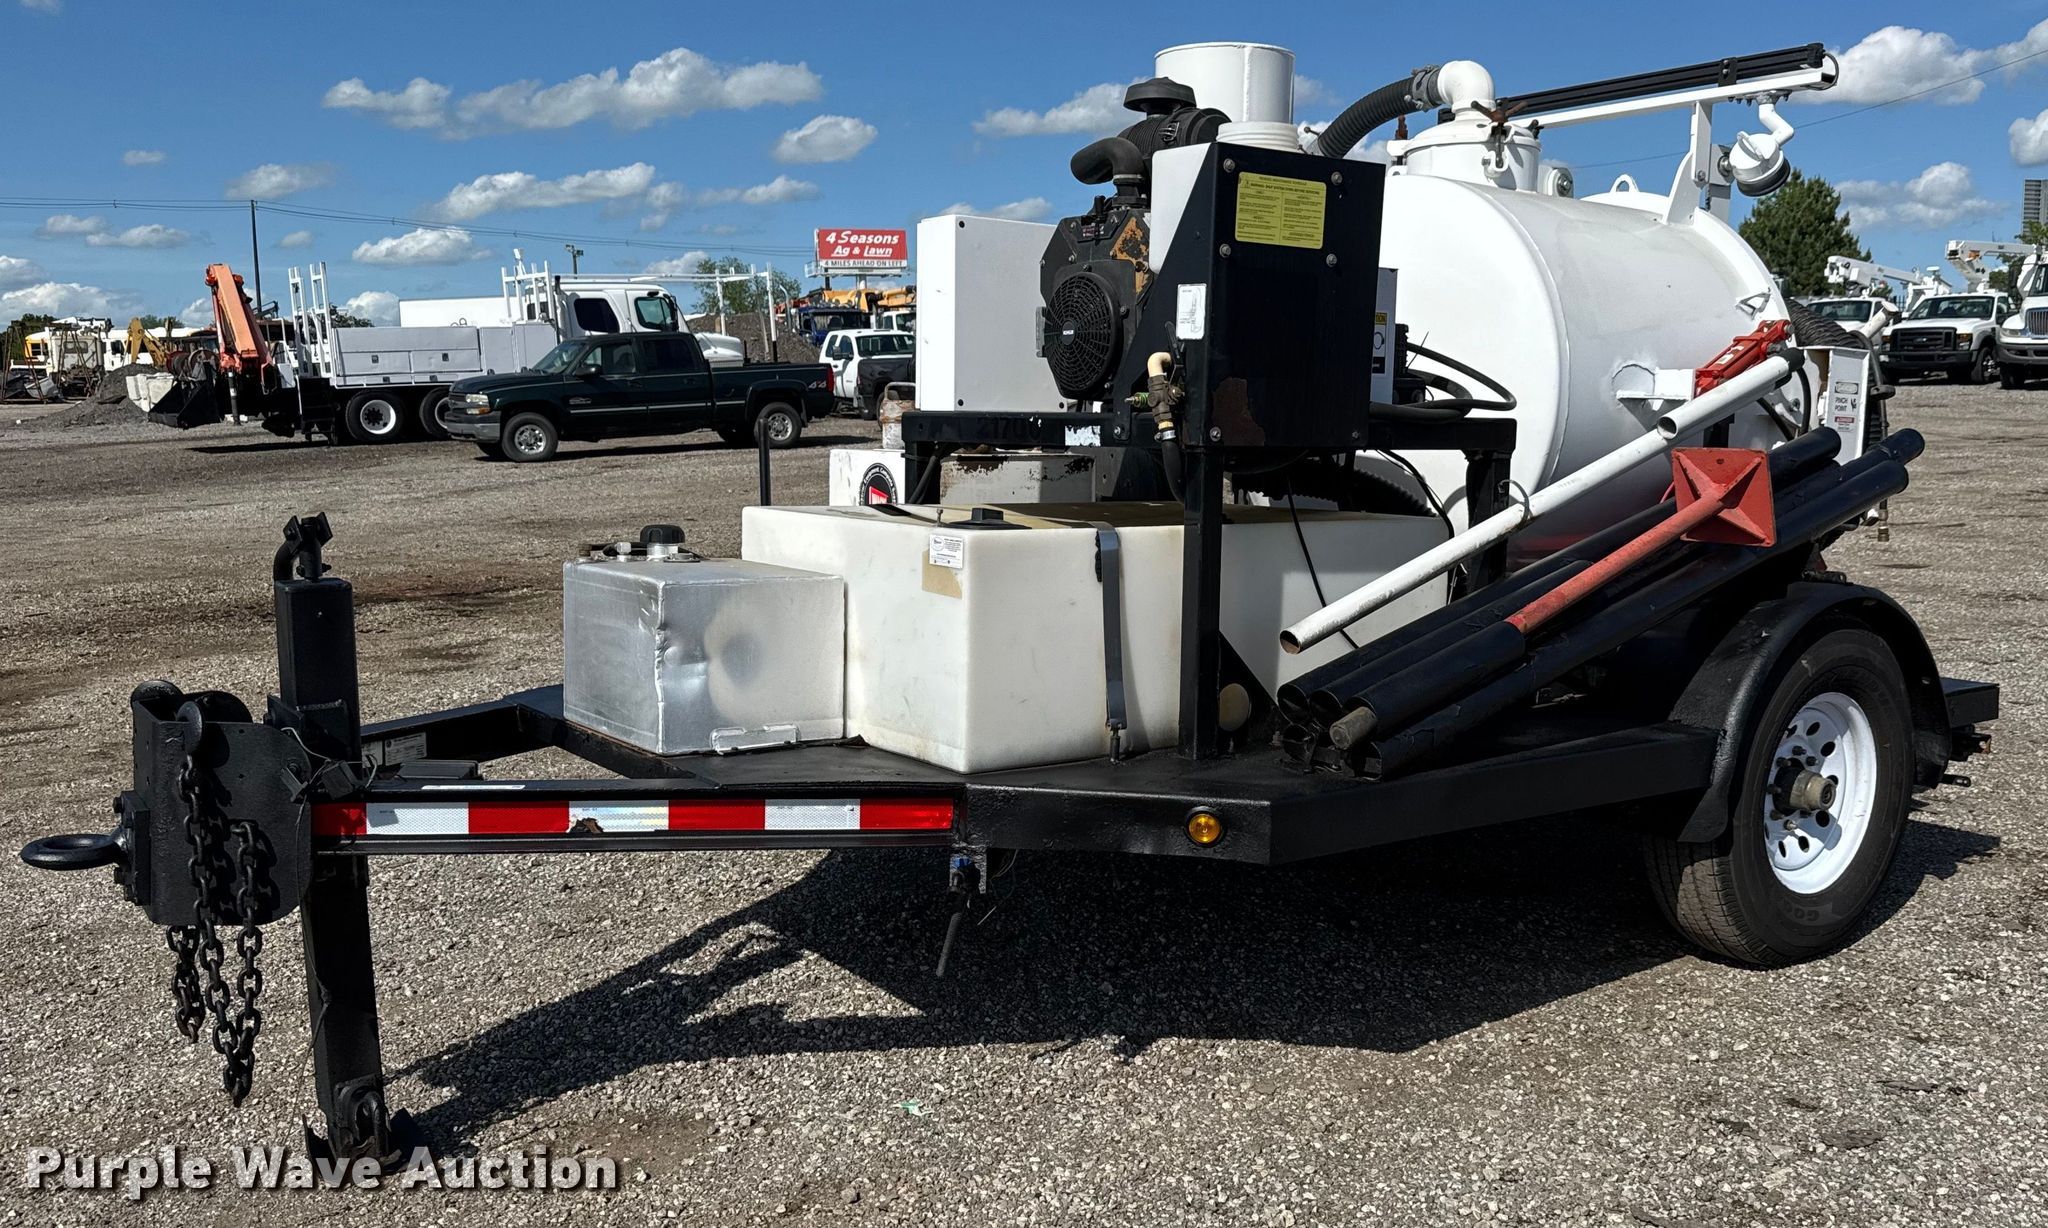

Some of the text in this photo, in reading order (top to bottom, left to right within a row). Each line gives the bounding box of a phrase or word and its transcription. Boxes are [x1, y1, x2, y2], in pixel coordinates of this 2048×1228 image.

[826, 230, 899, 245] 4 Seasons
[832, 245, 893, 257] Ag & Lawn
